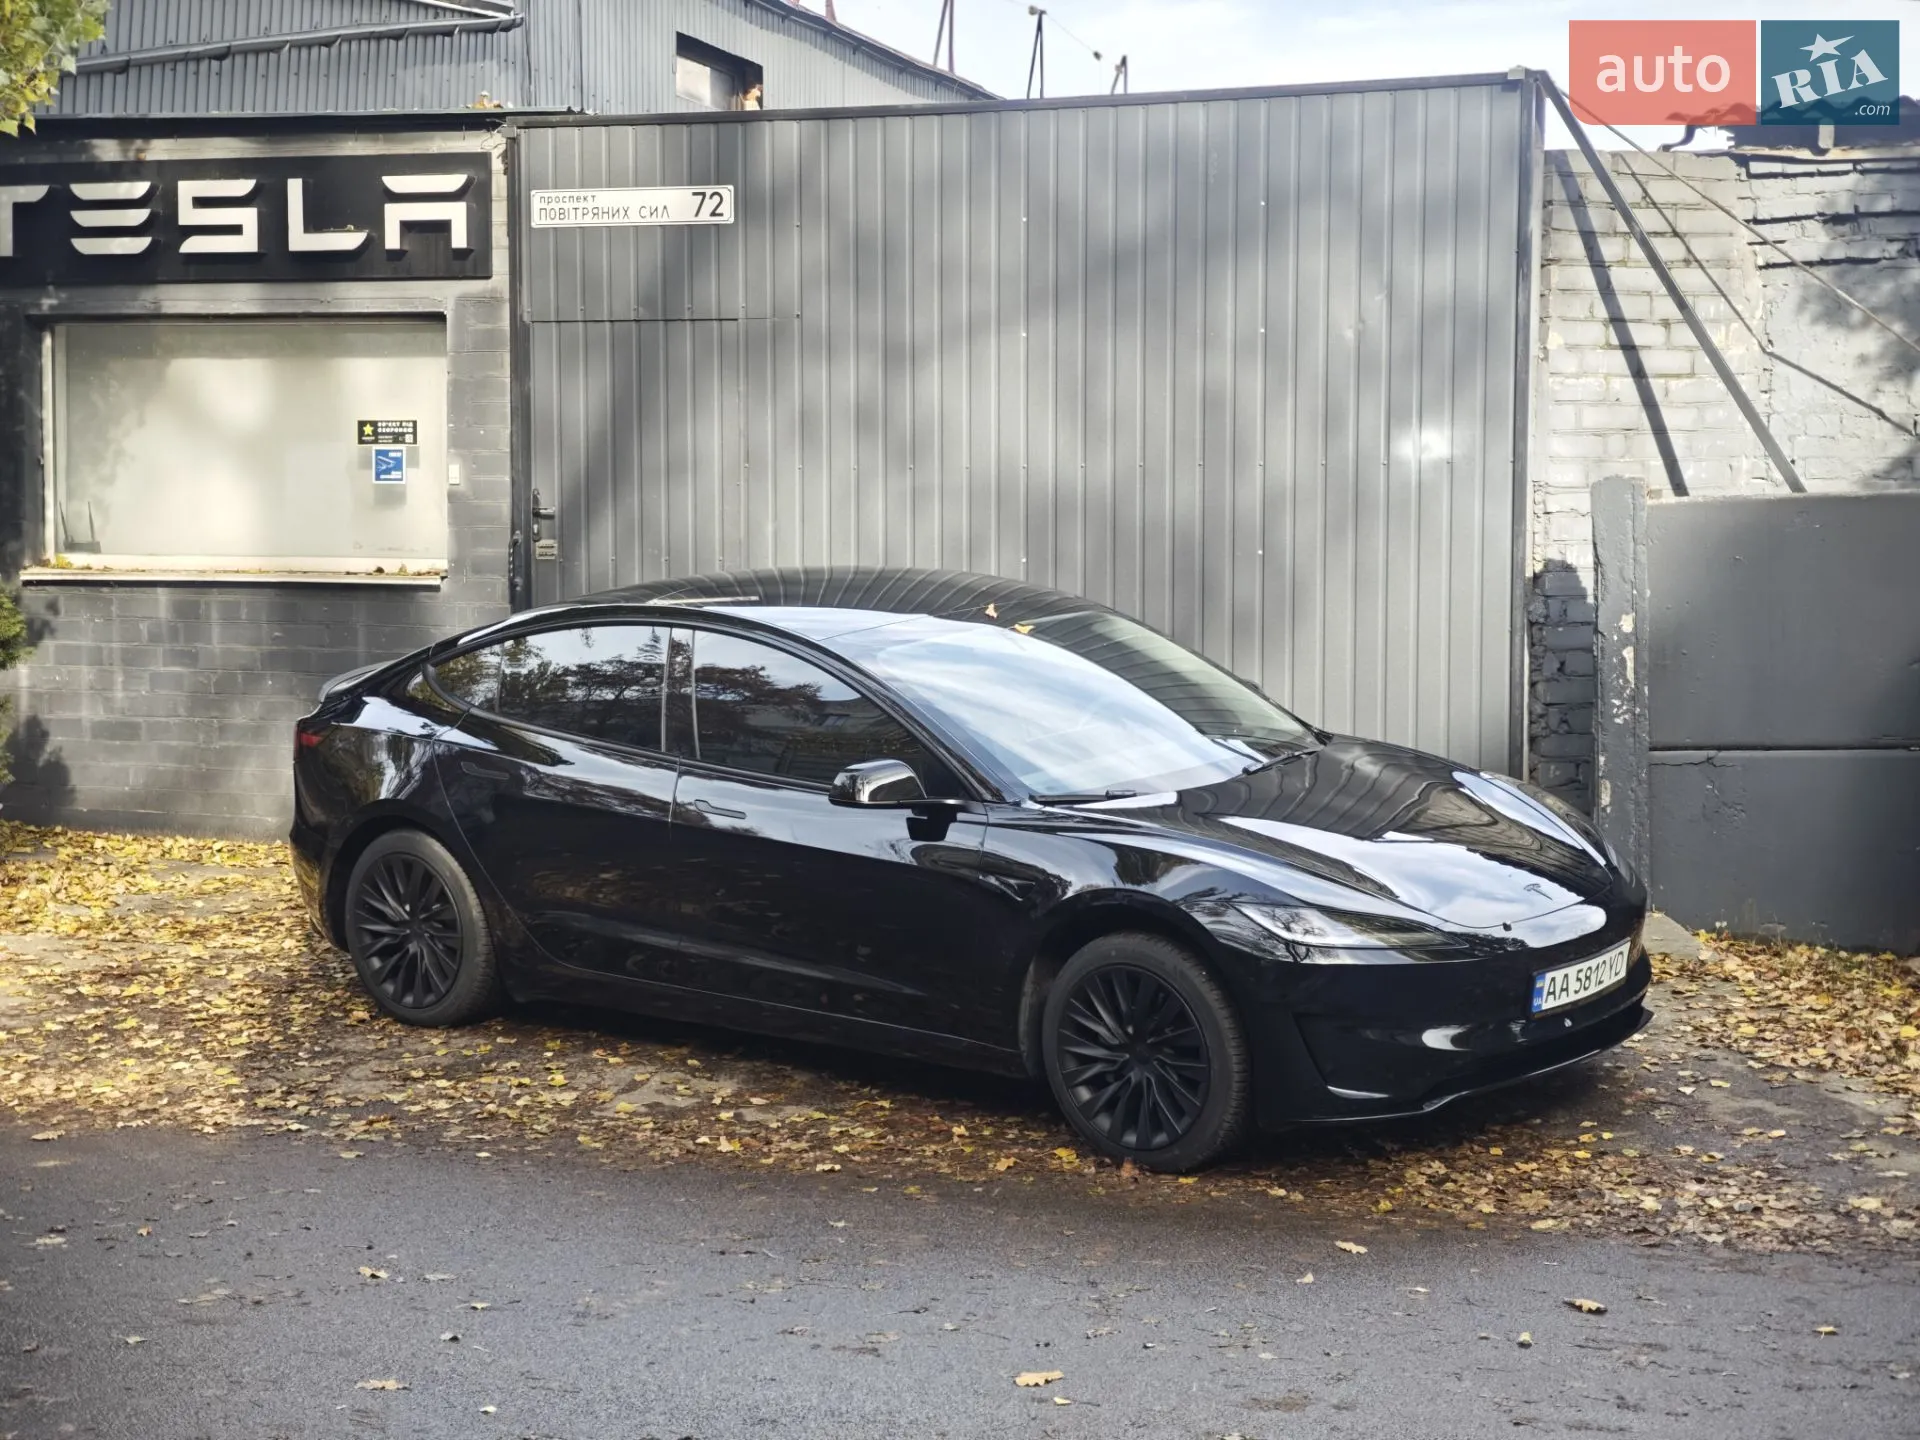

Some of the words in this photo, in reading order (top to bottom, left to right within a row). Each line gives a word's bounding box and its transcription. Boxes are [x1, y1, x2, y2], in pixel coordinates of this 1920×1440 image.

[539, 194, 597, 205] проспект
[691, 191, 724, 217] 72
[538, 206, 630, 221] ПОВІТРЯНИХ
[638, 205, 671, 220] СИЛ
[1544, 973, 1570, 1004] AA
[1573, 959, 1607, 995] 5812
